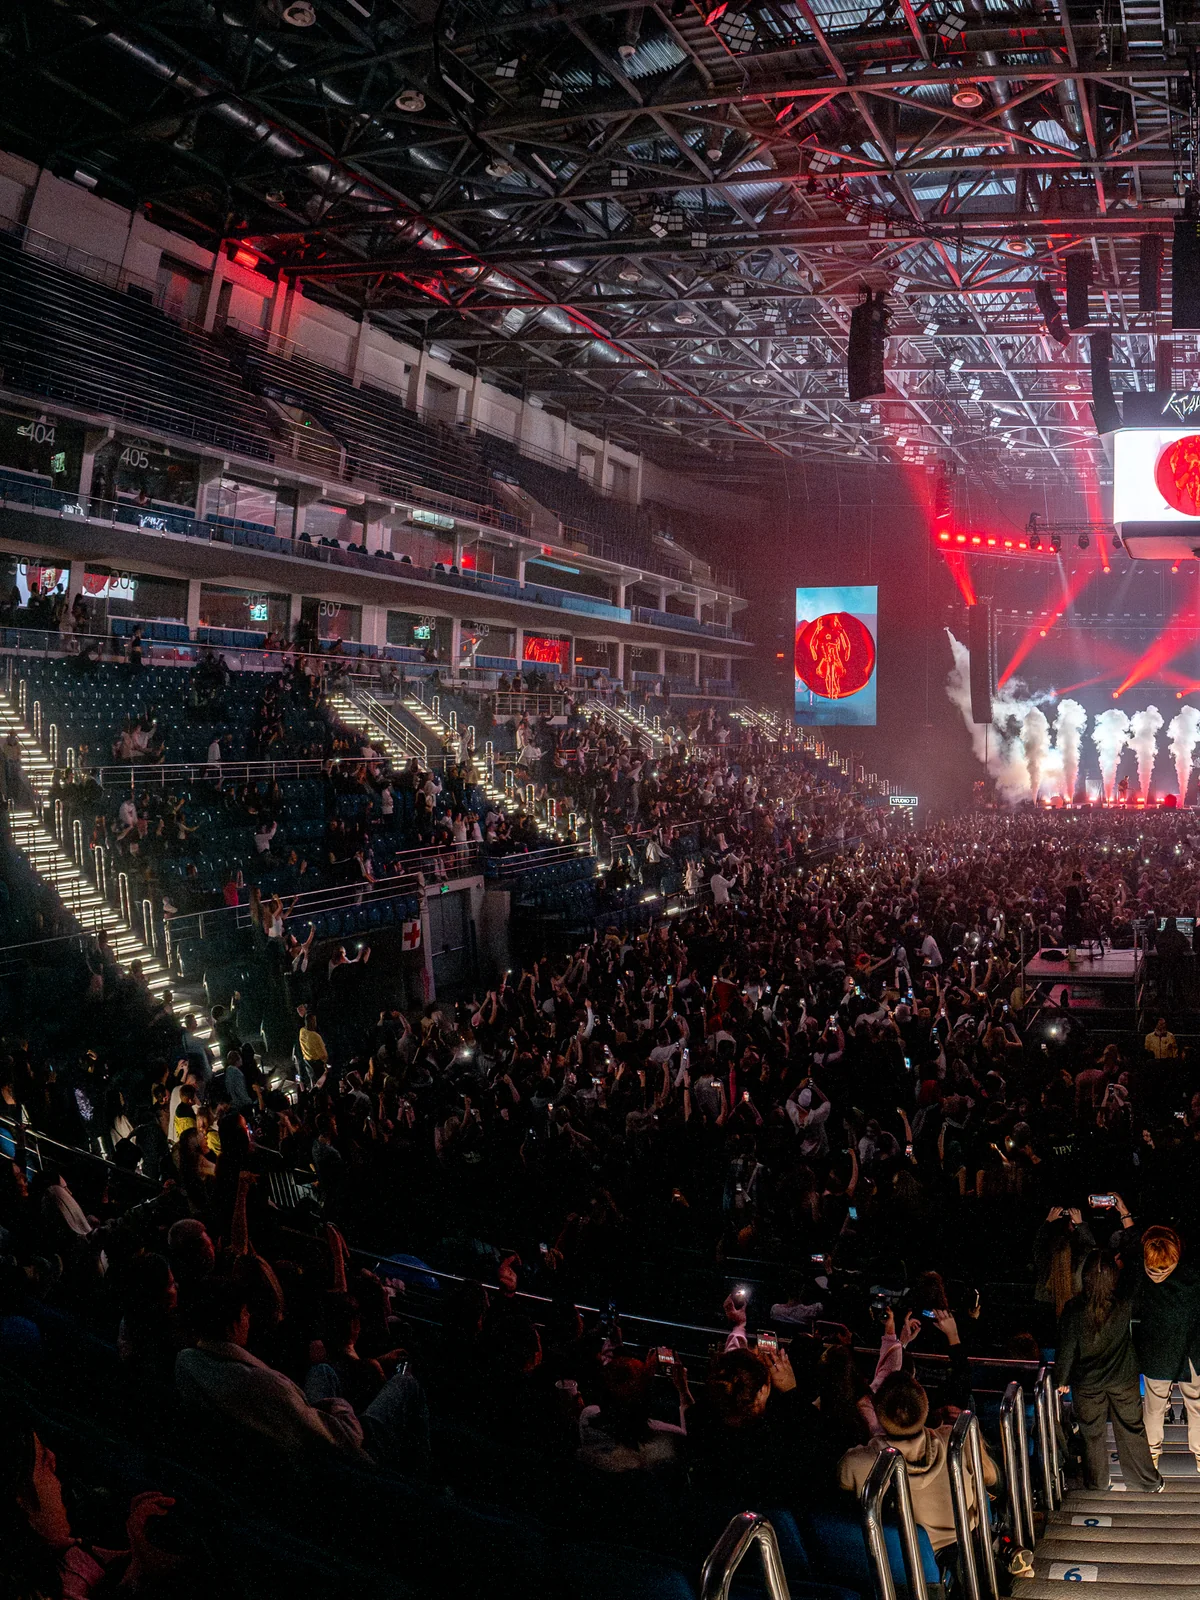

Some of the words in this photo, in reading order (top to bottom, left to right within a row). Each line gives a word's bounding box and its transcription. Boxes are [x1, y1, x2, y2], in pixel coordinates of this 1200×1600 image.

[26, 423, 56, 446] 404
[120, 448, 149, 469] 405
[110, 571, 139, 591] 305
[319, 601, 342, 618] 307
[418, 615, 436, 631] 308
[473, 622, 490, 637] 309
[631, 646, 642, 658] 312
